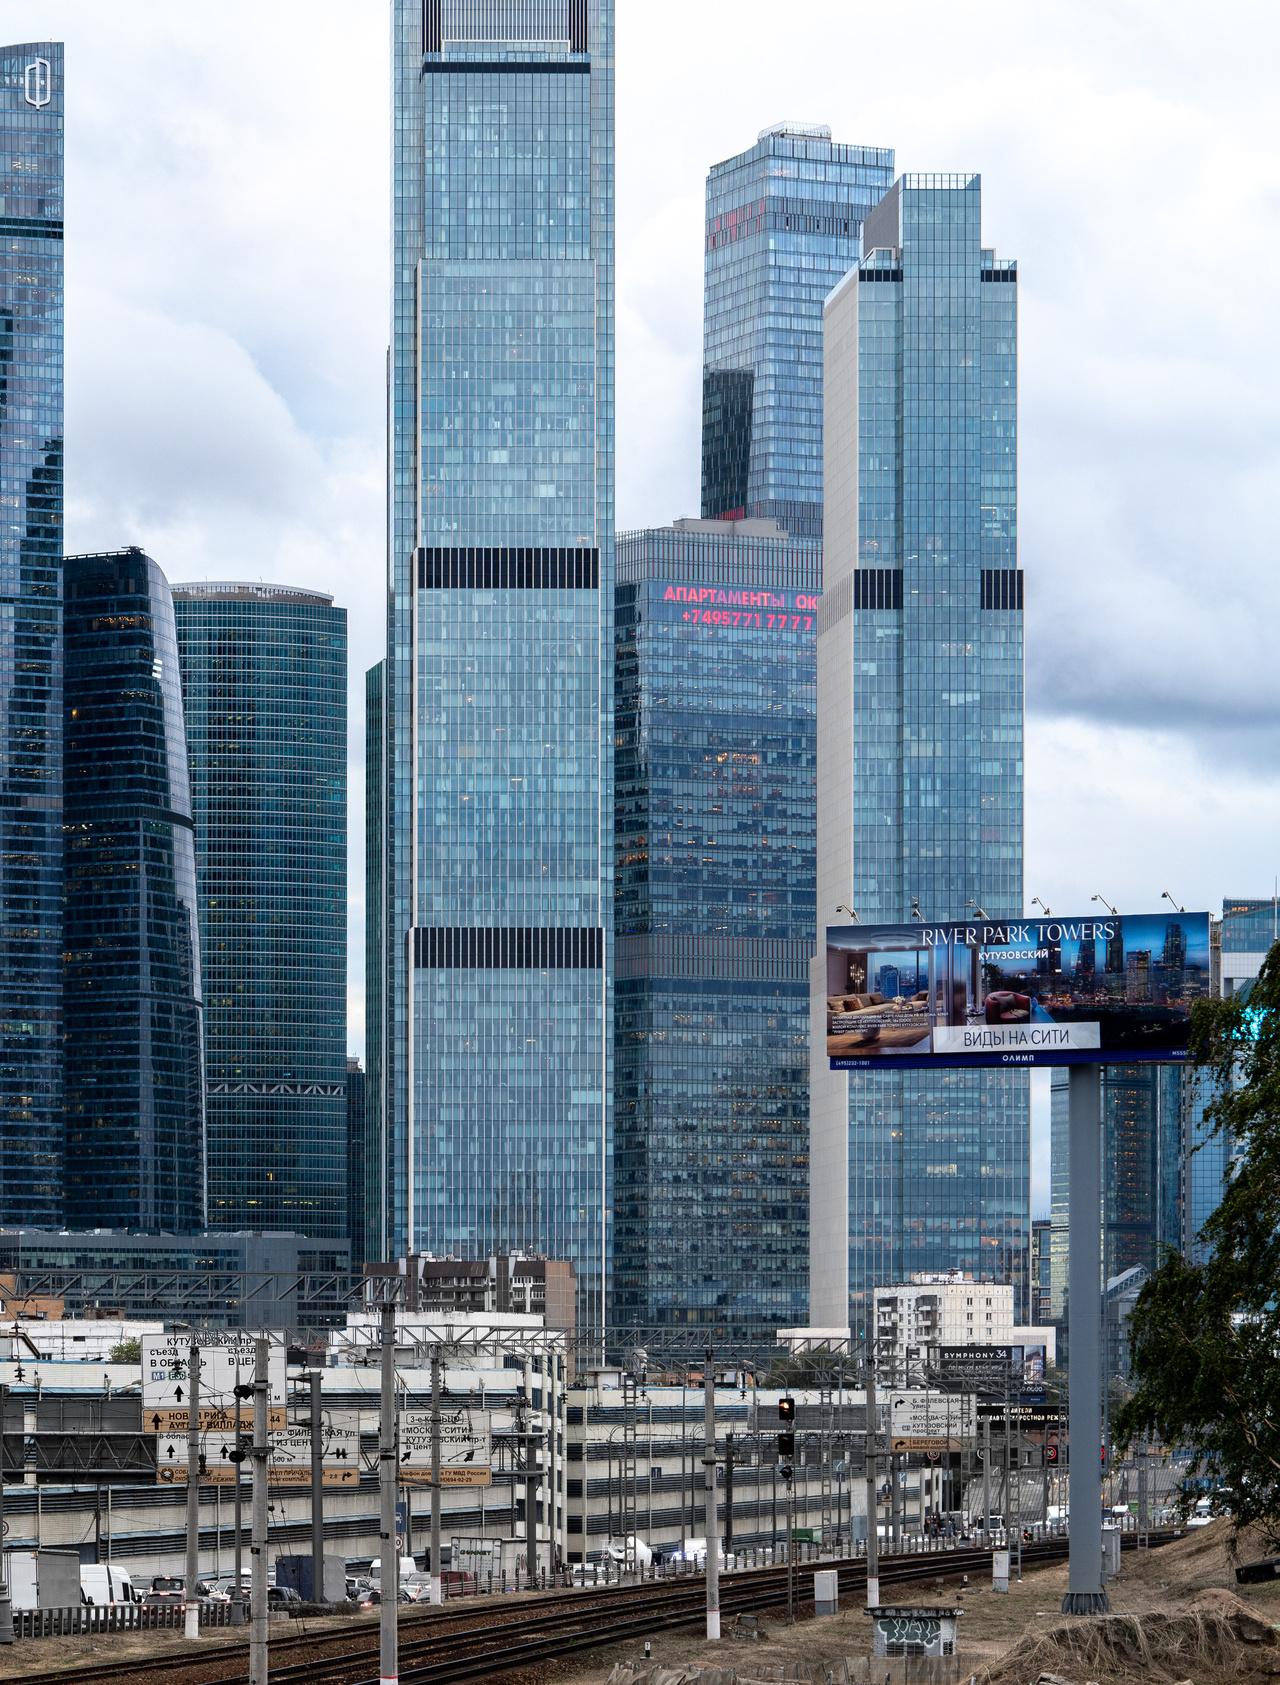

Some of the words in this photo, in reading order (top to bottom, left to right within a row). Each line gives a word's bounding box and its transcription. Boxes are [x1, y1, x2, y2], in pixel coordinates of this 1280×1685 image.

[664, 585, 785, 608] АПАРТАМЕНТЫ
[914, 927, 977, 946] RIVER
[983, 925, 1031, 943] PARK
[978, 948, 1049, 961] КУТУЗОВСКИЙ
[964, 1030, 1005, 1049] ВИДЫ
[1009, 1030, 1028, 1045] НА
[1031, 1029, 1070, 1044] СИТИ
[1002, 1054, 1035, 1062] ОЛИМП
[150, 1347, 179, 1356] съезд
[227, 1346, 256, 1356] съезд
[995, 1349, 1008, 1359] 34
[150, 1359, 157, 1368] В
[228, 1358, 235, 1366] В
[270, 1415, 281, 1423] 44
[424, 1414, 461, 1424] КОЬЦО
[287, 1428, 343, 1437] ФИЛЕСКАЯ
[276, 1439, 288, 1447] ИЗ
